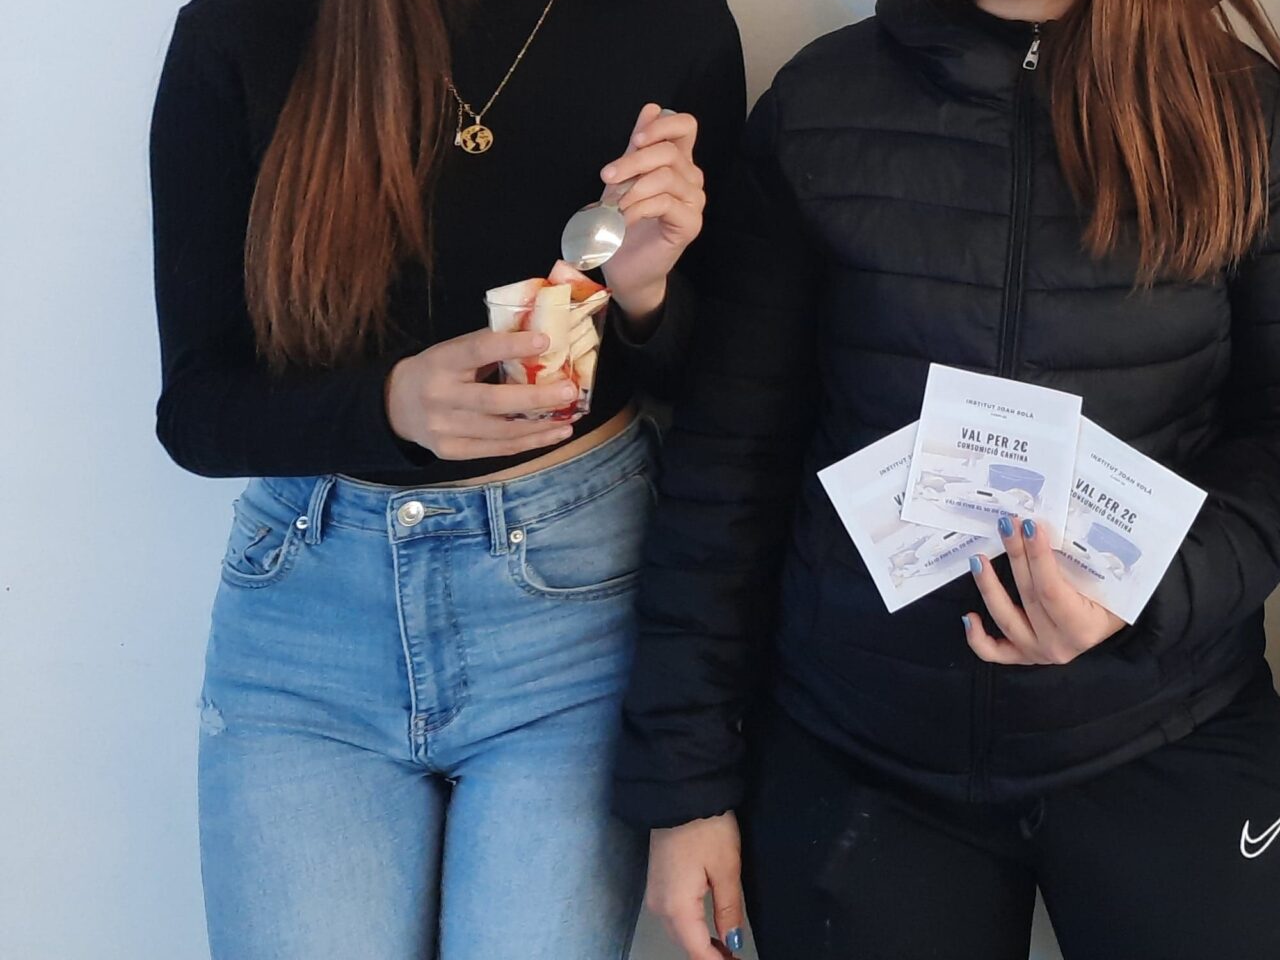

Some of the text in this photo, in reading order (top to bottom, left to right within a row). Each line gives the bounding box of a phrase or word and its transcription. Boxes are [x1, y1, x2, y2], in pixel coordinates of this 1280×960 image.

[965, 398, 996, 411] INSTITUT
[961, 427, 982, 443] VAL
[986, 433, 1009, 449] PER
[957, 441, 1028, 463] CONSUMICIÓ CANTINA
[1090, 452, 1118, 473] INSTITUT
[1075, 477, 1096, 499] VAL
[1096, 492, 1120, 515] PER
[1106, 513, 1133, 534] CANTINA
